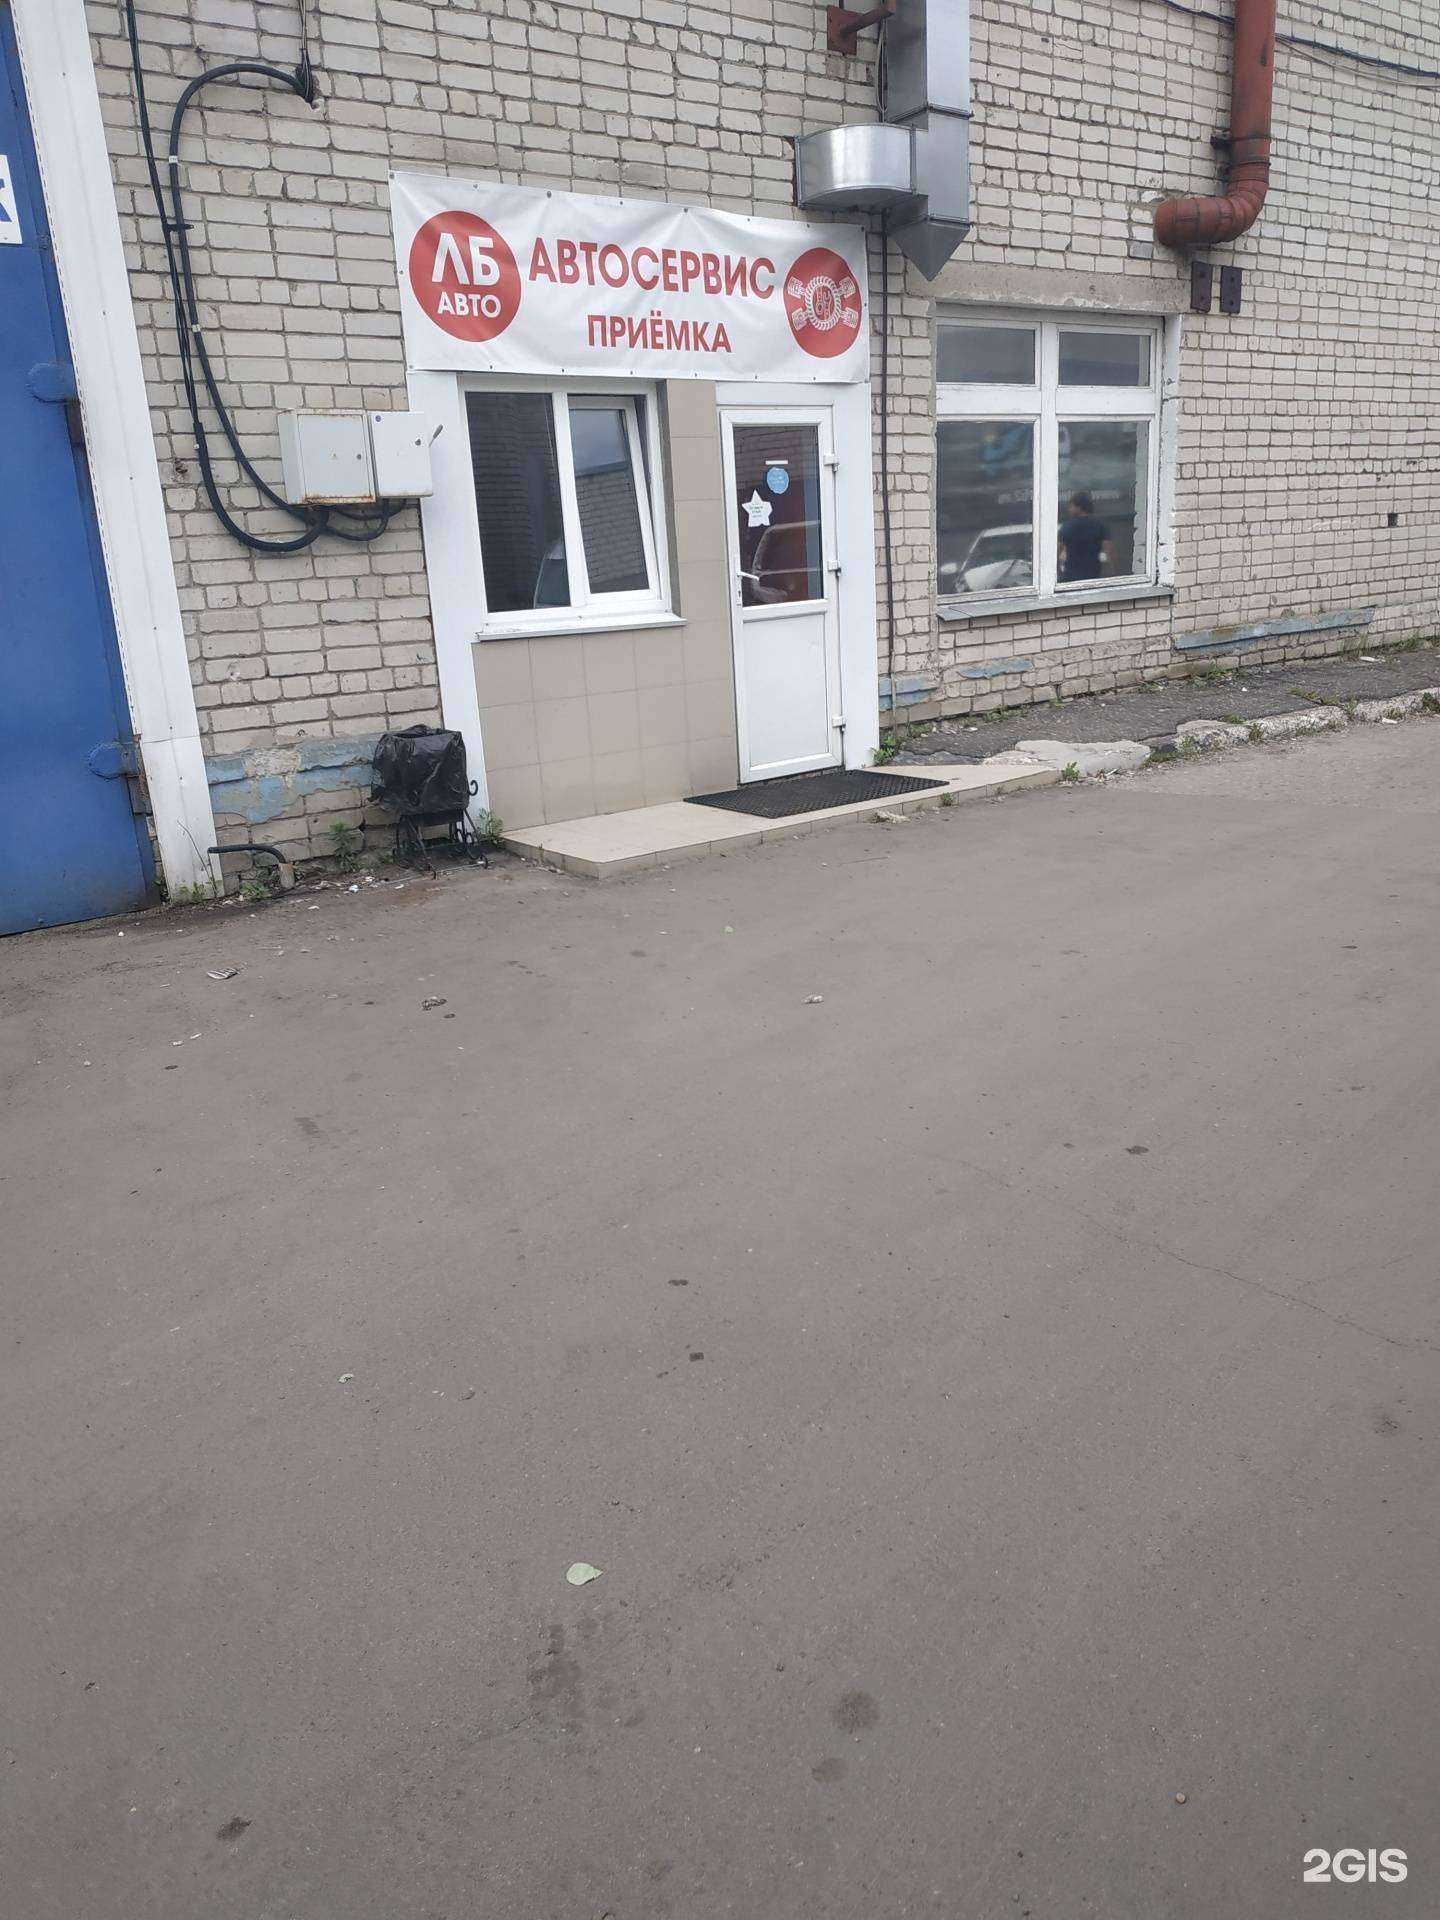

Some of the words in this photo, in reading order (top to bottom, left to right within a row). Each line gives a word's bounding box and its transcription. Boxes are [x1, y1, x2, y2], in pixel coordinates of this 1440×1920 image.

[431, 232, 501, 287] ЛБ
[528, 236, 776, 300] АВТОСЕРВИС
[436, 290, 502, 319] АВТО
[586, 309, 733, 353] ПРИЁМКА
